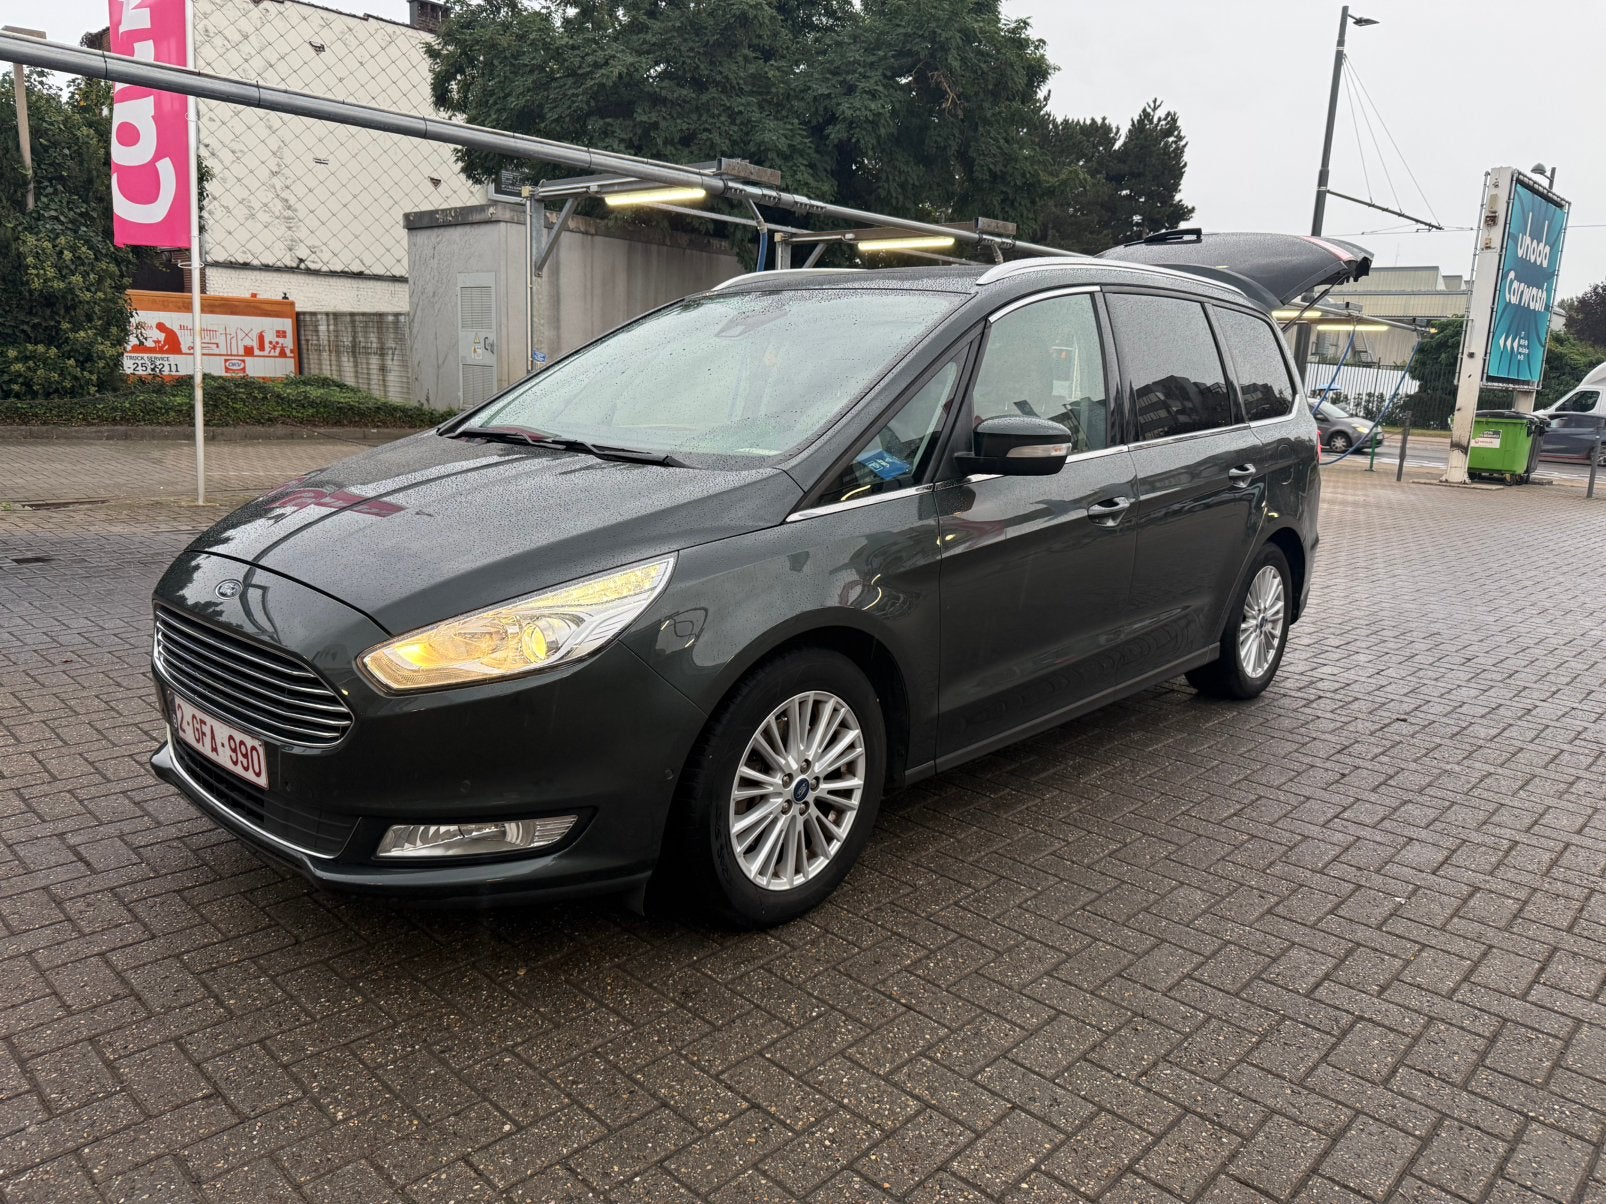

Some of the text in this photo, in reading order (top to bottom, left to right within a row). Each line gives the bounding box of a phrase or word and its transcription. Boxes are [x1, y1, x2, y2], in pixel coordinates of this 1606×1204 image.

[1517, 212, 1551, 268] uhoda
[1505, 270, 1547, 312] Carwash
[177, 703, 262, 778] 2-GFA-990
